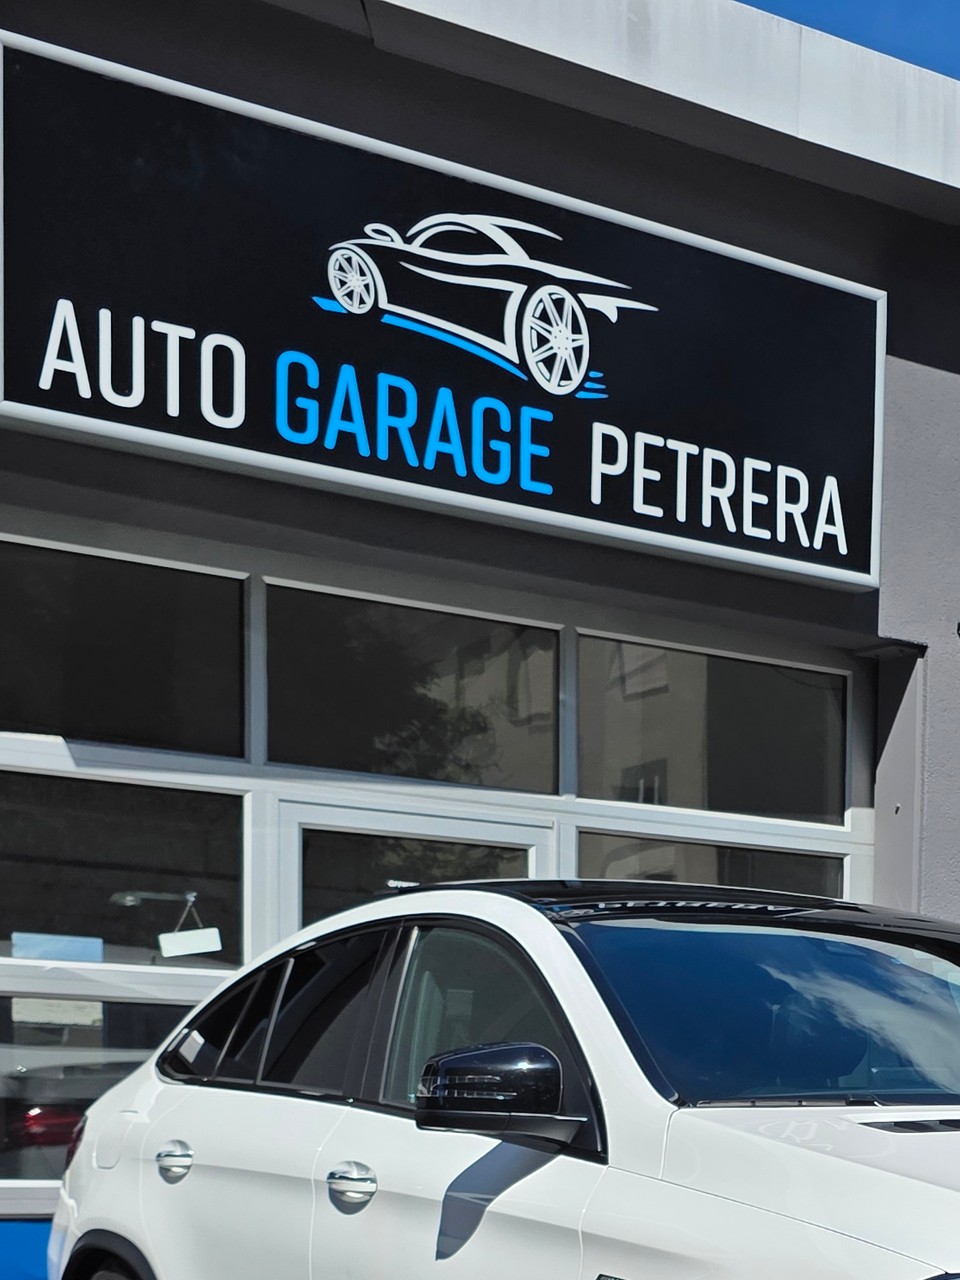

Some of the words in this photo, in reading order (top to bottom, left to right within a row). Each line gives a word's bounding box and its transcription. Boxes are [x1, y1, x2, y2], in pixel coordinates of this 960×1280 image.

[37, 299, 246, 429] AUTO
[274, 350, 554, 496] GARAGE
[589, 422, 849, 555] PETRERA
